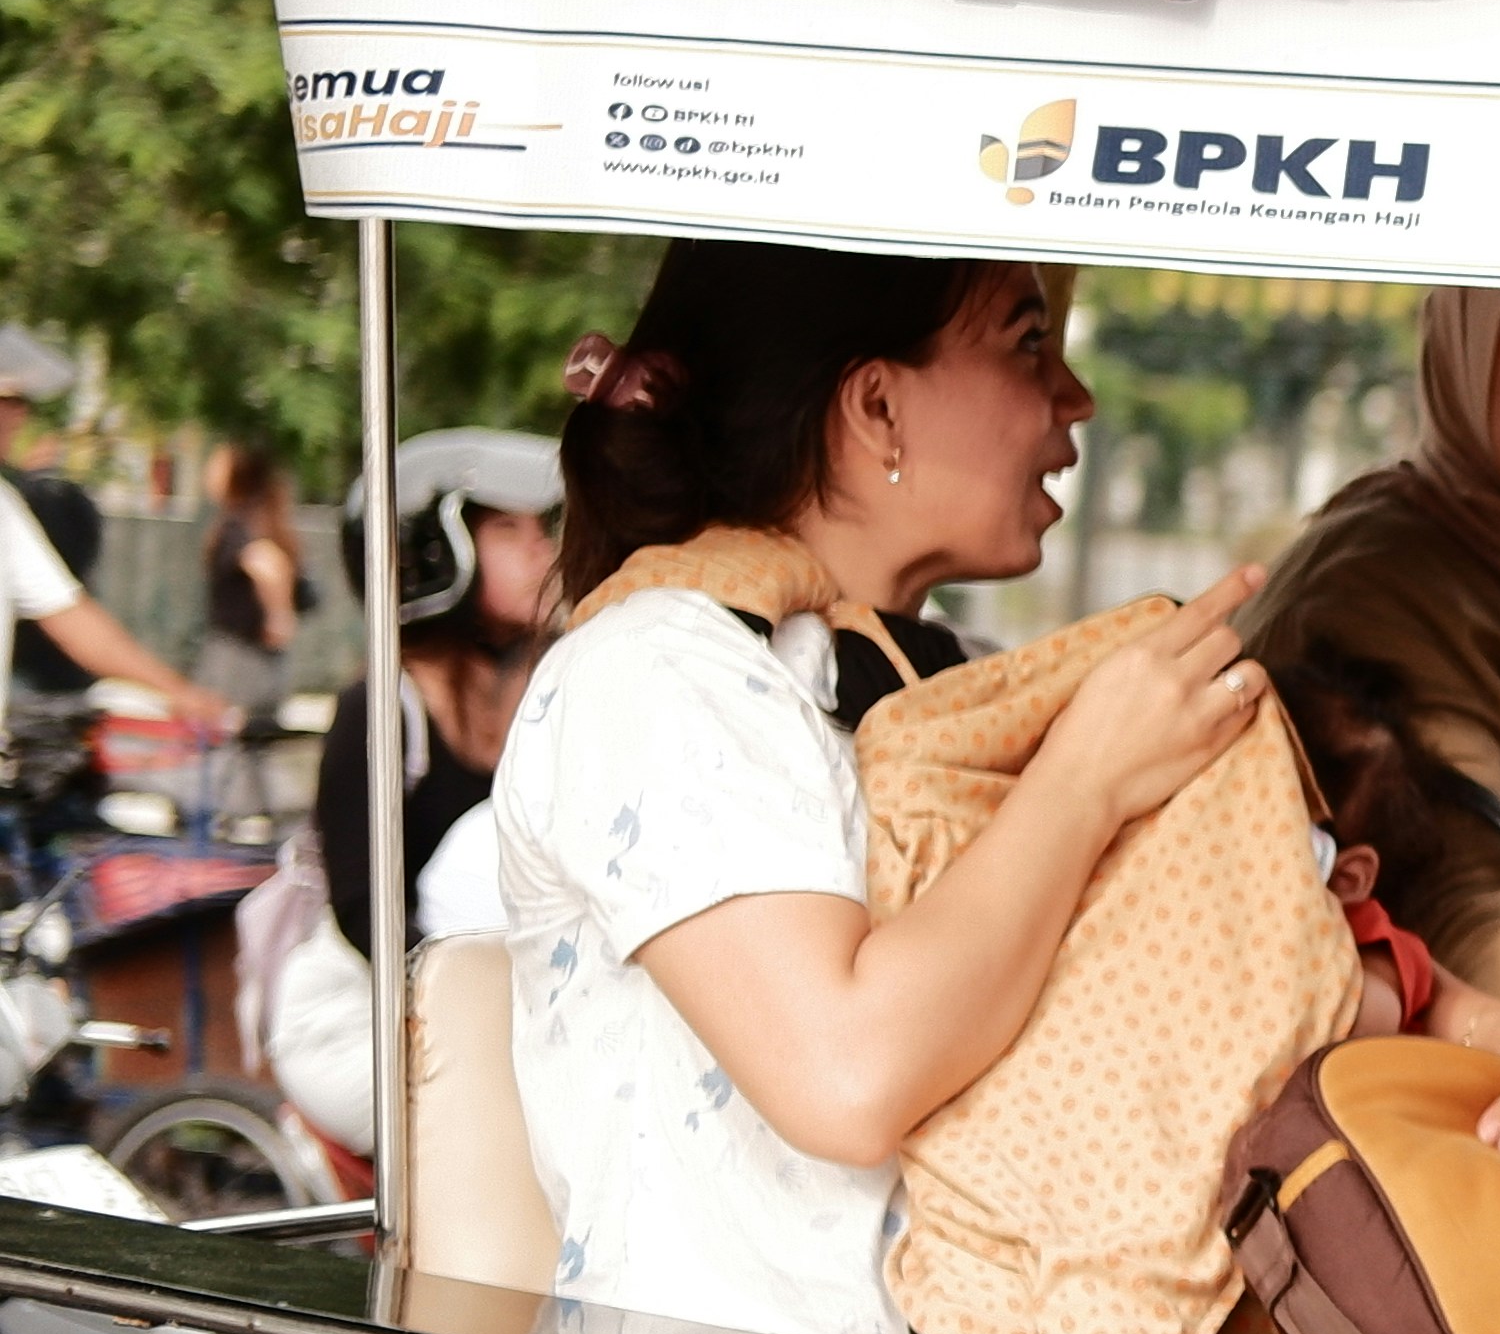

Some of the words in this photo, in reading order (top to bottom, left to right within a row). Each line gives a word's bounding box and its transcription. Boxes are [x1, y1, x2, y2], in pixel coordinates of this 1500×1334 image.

[286, 67, 446, 105] emua
[613, 72, 674, 89] follow
[1091, 124, 1431, 203] BPKH
[1048, 190, 1122, 211] Badan
[1129, 194, 1242, 217] Pengelola
[1250, 203, 1367, 227] Keuangan
[1374, 210, 1421, 231] Haji
